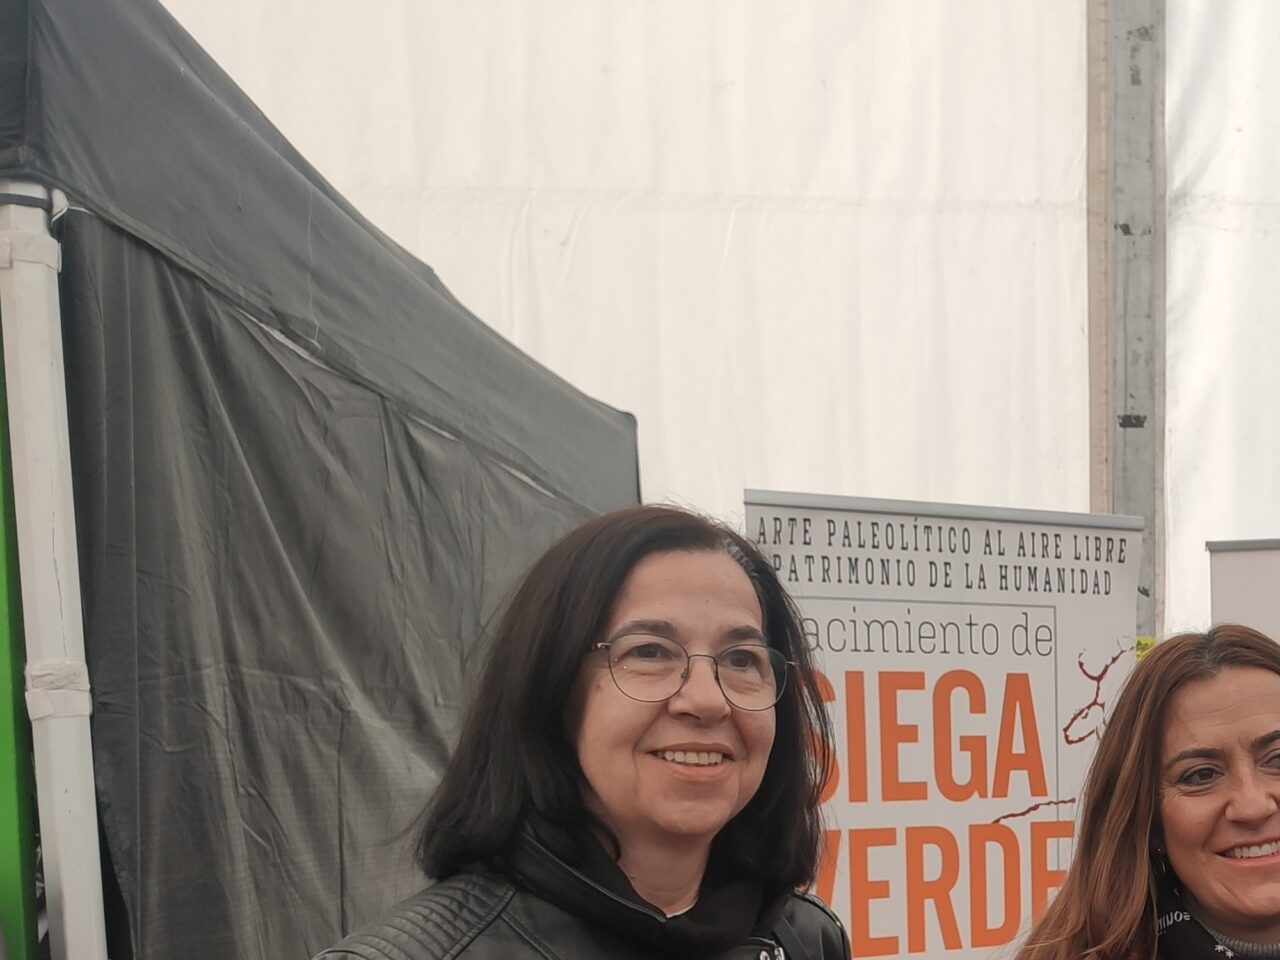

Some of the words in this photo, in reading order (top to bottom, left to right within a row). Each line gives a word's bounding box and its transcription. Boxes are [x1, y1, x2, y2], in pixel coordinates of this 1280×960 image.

[757, 515, 812, 546] ARTE
[826, 516, 971, 555] PALEOLÍTICO
[983, 529, 1006, 556] AL
[1017, 531, 1062, 559] AIRE
[1073, 534, 1127, 563] LIBRE
[773, 553, 916, 587] PATRIMONIO
[929, 560, 952, 588] DE
[965, 562, 987, 590] LA
[998, 564, 1112, 596] HUMANIDAD
[803, 606, 1000, 655] acimiento
[1011, 612, 1053, 656] de
